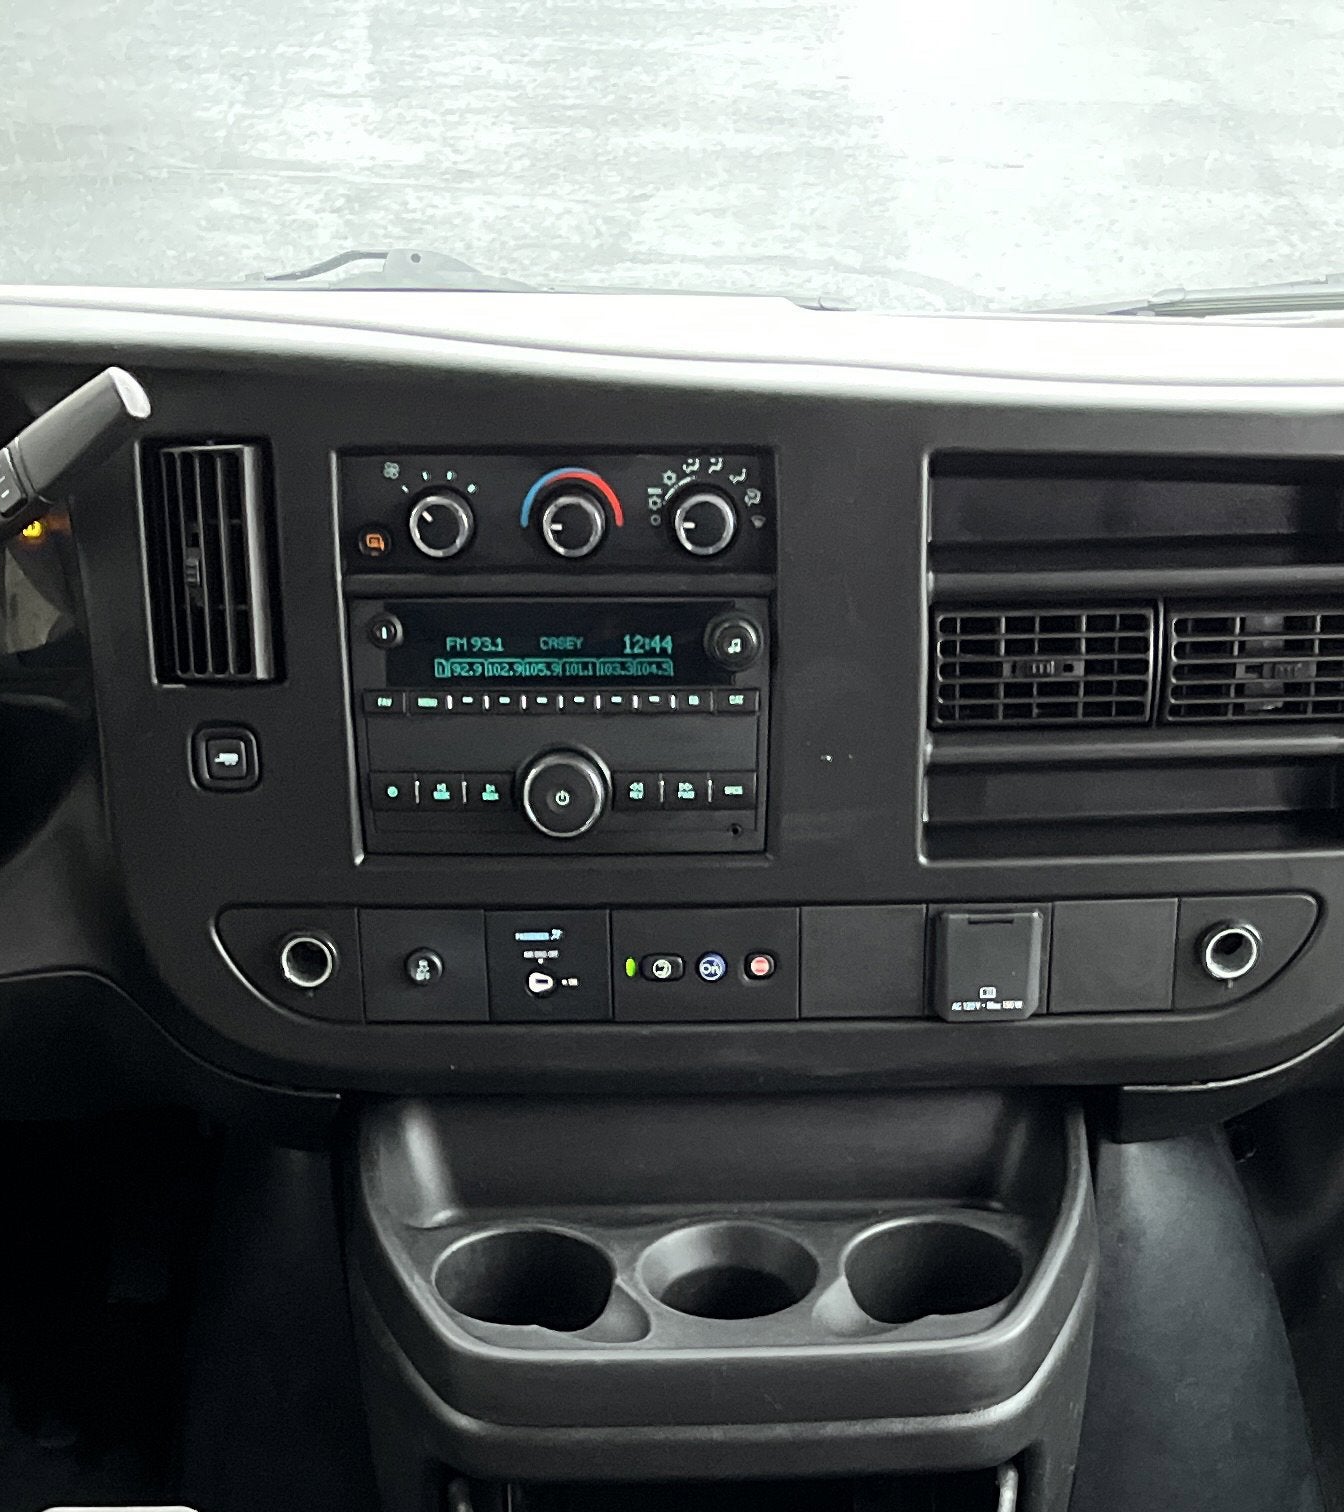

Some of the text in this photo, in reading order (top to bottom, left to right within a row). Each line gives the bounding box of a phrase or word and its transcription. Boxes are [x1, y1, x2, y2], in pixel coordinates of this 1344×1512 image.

[446, 637, 504, 651] FM 93.1
[539, 636, 584, 650] CASEY
[623, 634, 672, 654] 12:44
[452, 664, 482, 676] 92.9
